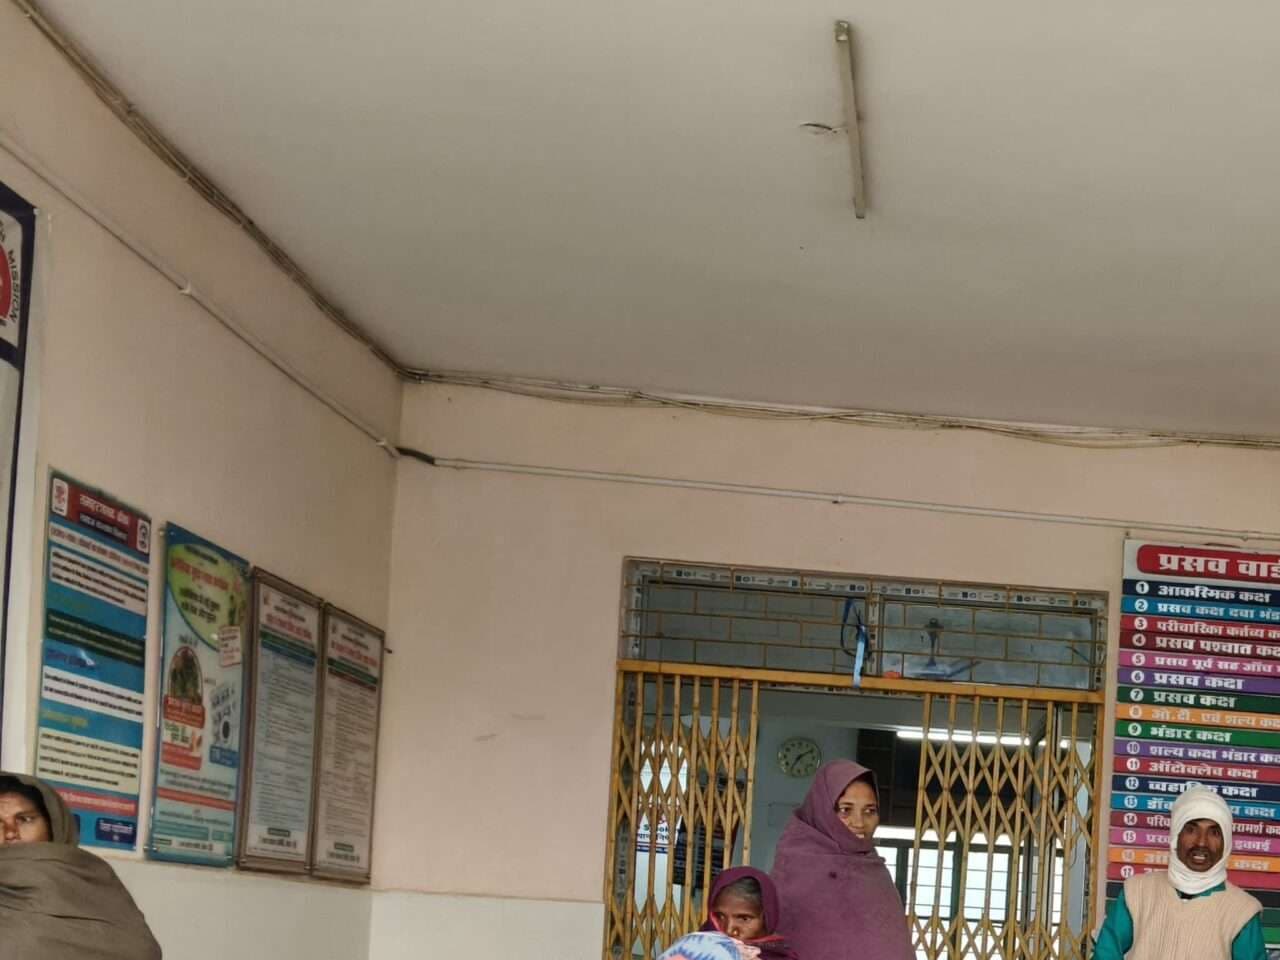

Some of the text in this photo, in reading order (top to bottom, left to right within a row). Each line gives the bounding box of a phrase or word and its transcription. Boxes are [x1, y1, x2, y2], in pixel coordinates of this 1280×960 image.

[1158, 553, 1230, 575] प्रसव
[1158, 585, 1236, 601] आकस्मिक
[1239, 591, 1272, 603] कक्ष
[1157, 602, 1191, 615] प्रसव
[1195, 605, 1225, 617] कक्ष
[1229, 607, 1256, 619] दवा
[1155, 636, 1196, 651] प्रसव
[1154, 656, 1188, 667] प्रसव
[1153, 672, 1200, 687] प्रसव
[1204, 676, 1245, 690] कक्ष
[1153, 691, 1196, 705] प्रसव
[1200, 694, 1238, 708] कक्ष
[1150, 725, 1192, 739] भंडार
[1196, 730, 1233, 743] कक्ष
[1149, 745, 1184, 758] शल्य
[1187, 748, 1217, 760] कक्ष
[1221, 749, 1258, 763] भंडार
[1227, 767, 1259, 779] कक्ष
[1221, 784, 1260, 797] कक्ष
[1244, 805, 1277, 817] कक्ष
